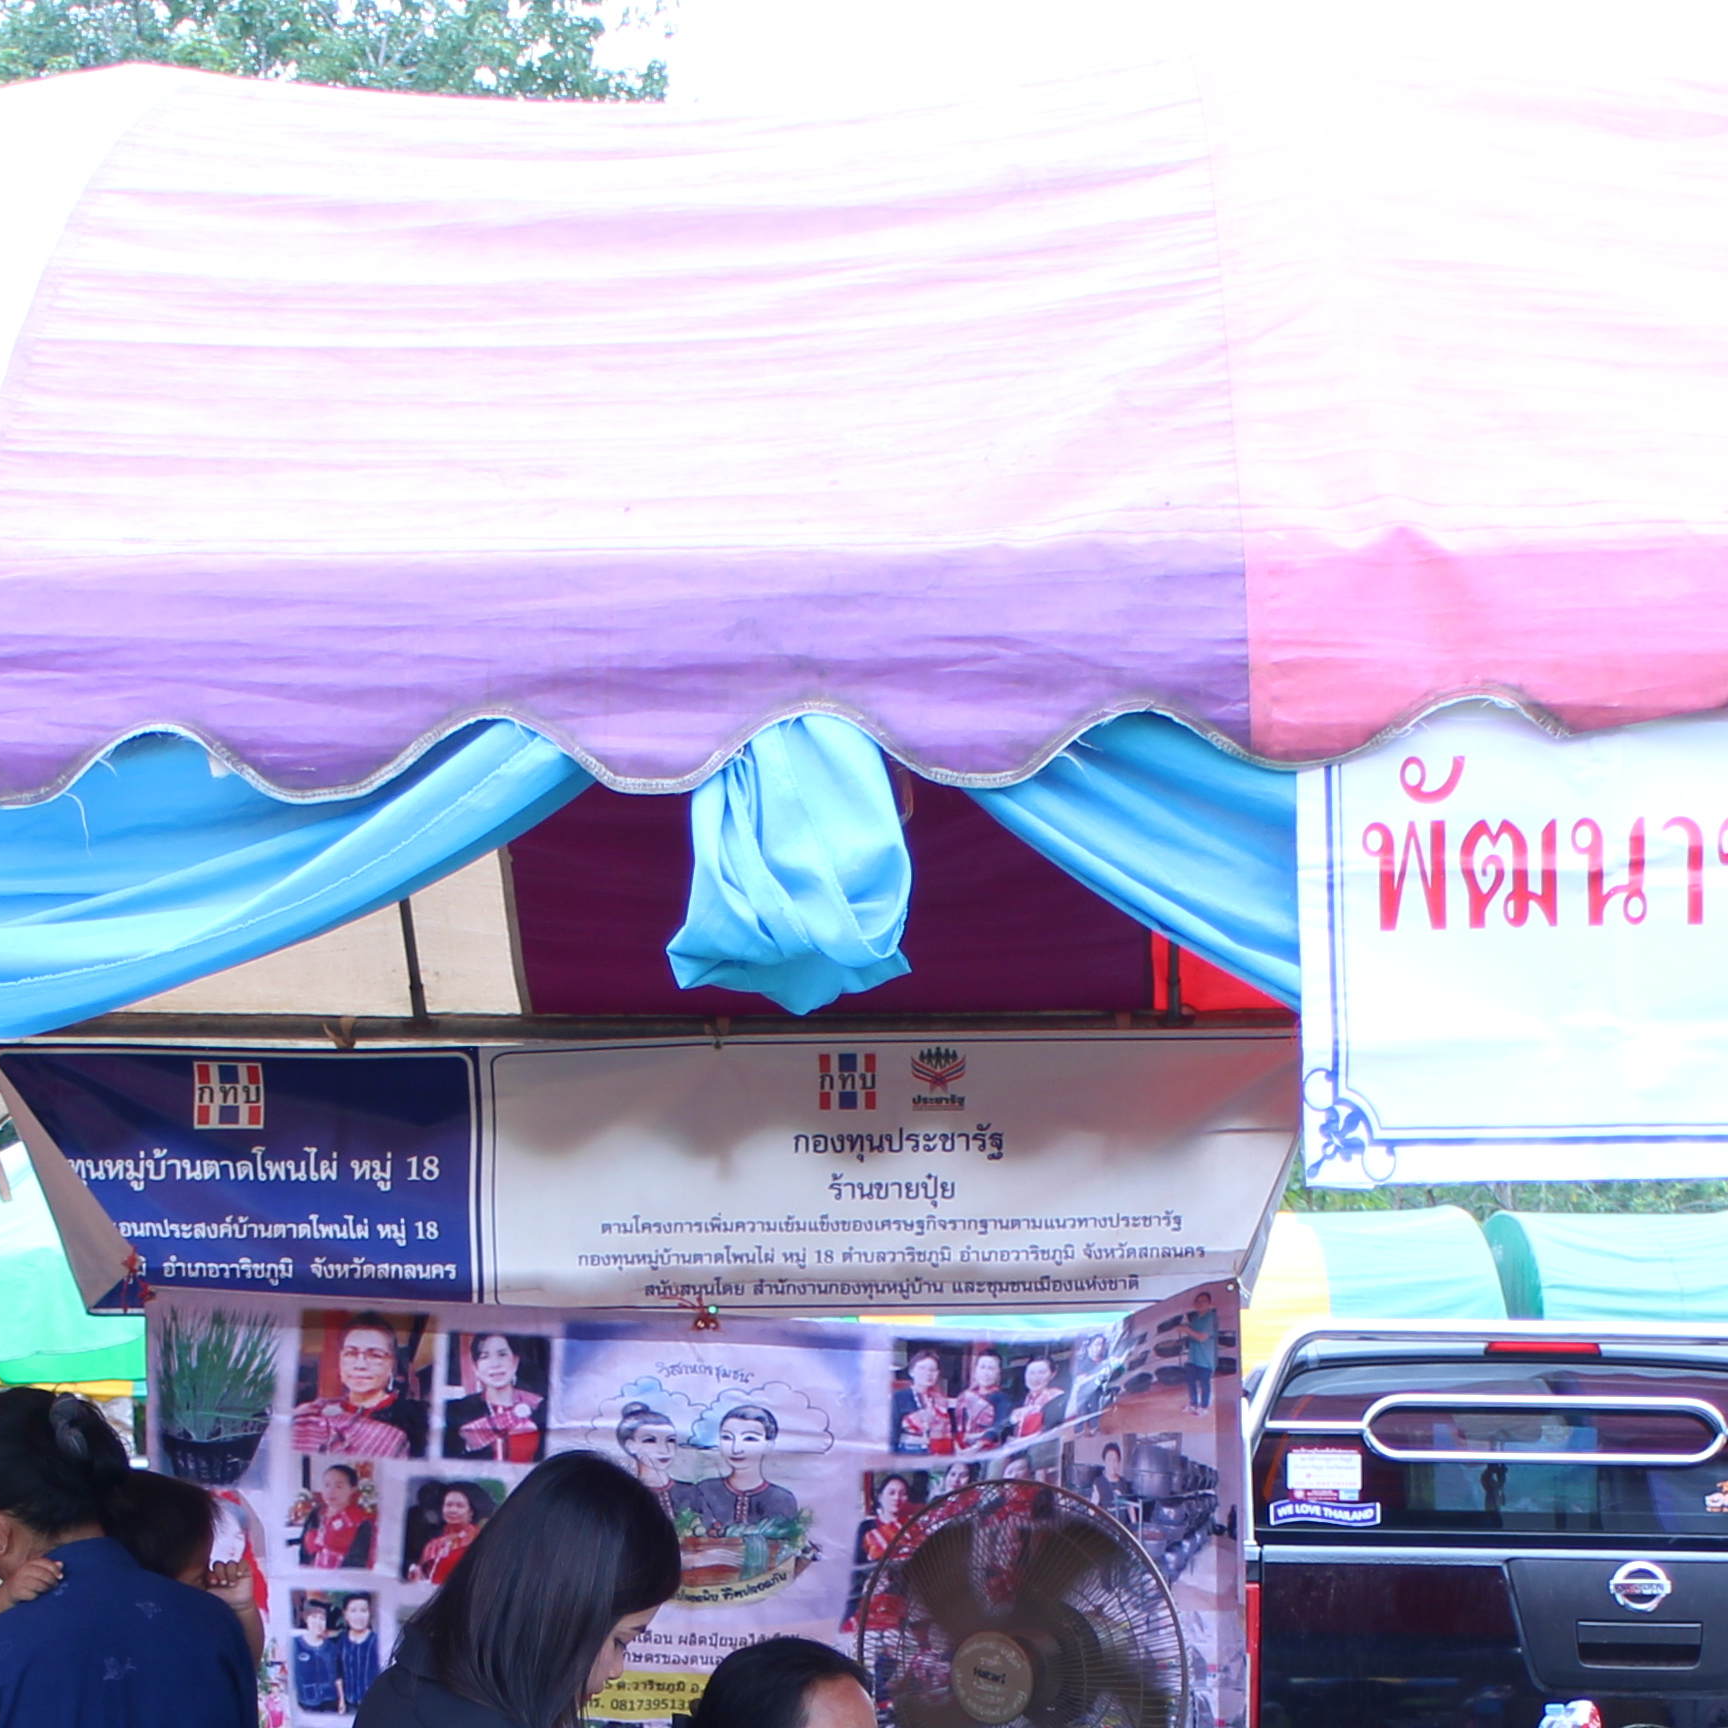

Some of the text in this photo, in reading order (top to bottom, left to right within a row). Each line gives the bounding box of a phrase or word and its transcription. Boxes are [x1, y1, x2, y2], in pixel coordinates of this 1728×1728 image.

[197, 1082, 263, 1105] กทบ
[819, 1071, 877, 1091] กทบ
[793, 1122, 1005, 1163] กองทุนประชารัฐ
[351, 1153, 392, 1192] หมู่
[406, 1155, 441, 1181] 18
[828, 1173, 956, 1209] ร้านขายปุ๋ย
[113, 1214, 440, 1247] อนกประสงค์บ้านตาดโพนไผ่ หมู่ 18
[163, 1255, 294, 1286] อำเภอวาริชภูมิ
[309, 1257, 457, 1281] จังหวัดสกลนคร
[578, 1242, 1206, 1271] กองทุนหมู่บ้านตาดโพนไผ่ หมู่ 18 ตำบลวาริชภูมิ อำเภอวาริชภูมิ จังหวัดสกลนคร
[645, 1273, 1140, 1300] สนับสนุนโดย สำนักงานกองทุนหมู่บ้าน และชุมชนเมืองแห่งชาติ
[1277, 1503, 1374, 1521] WE LOVE THAILAND
